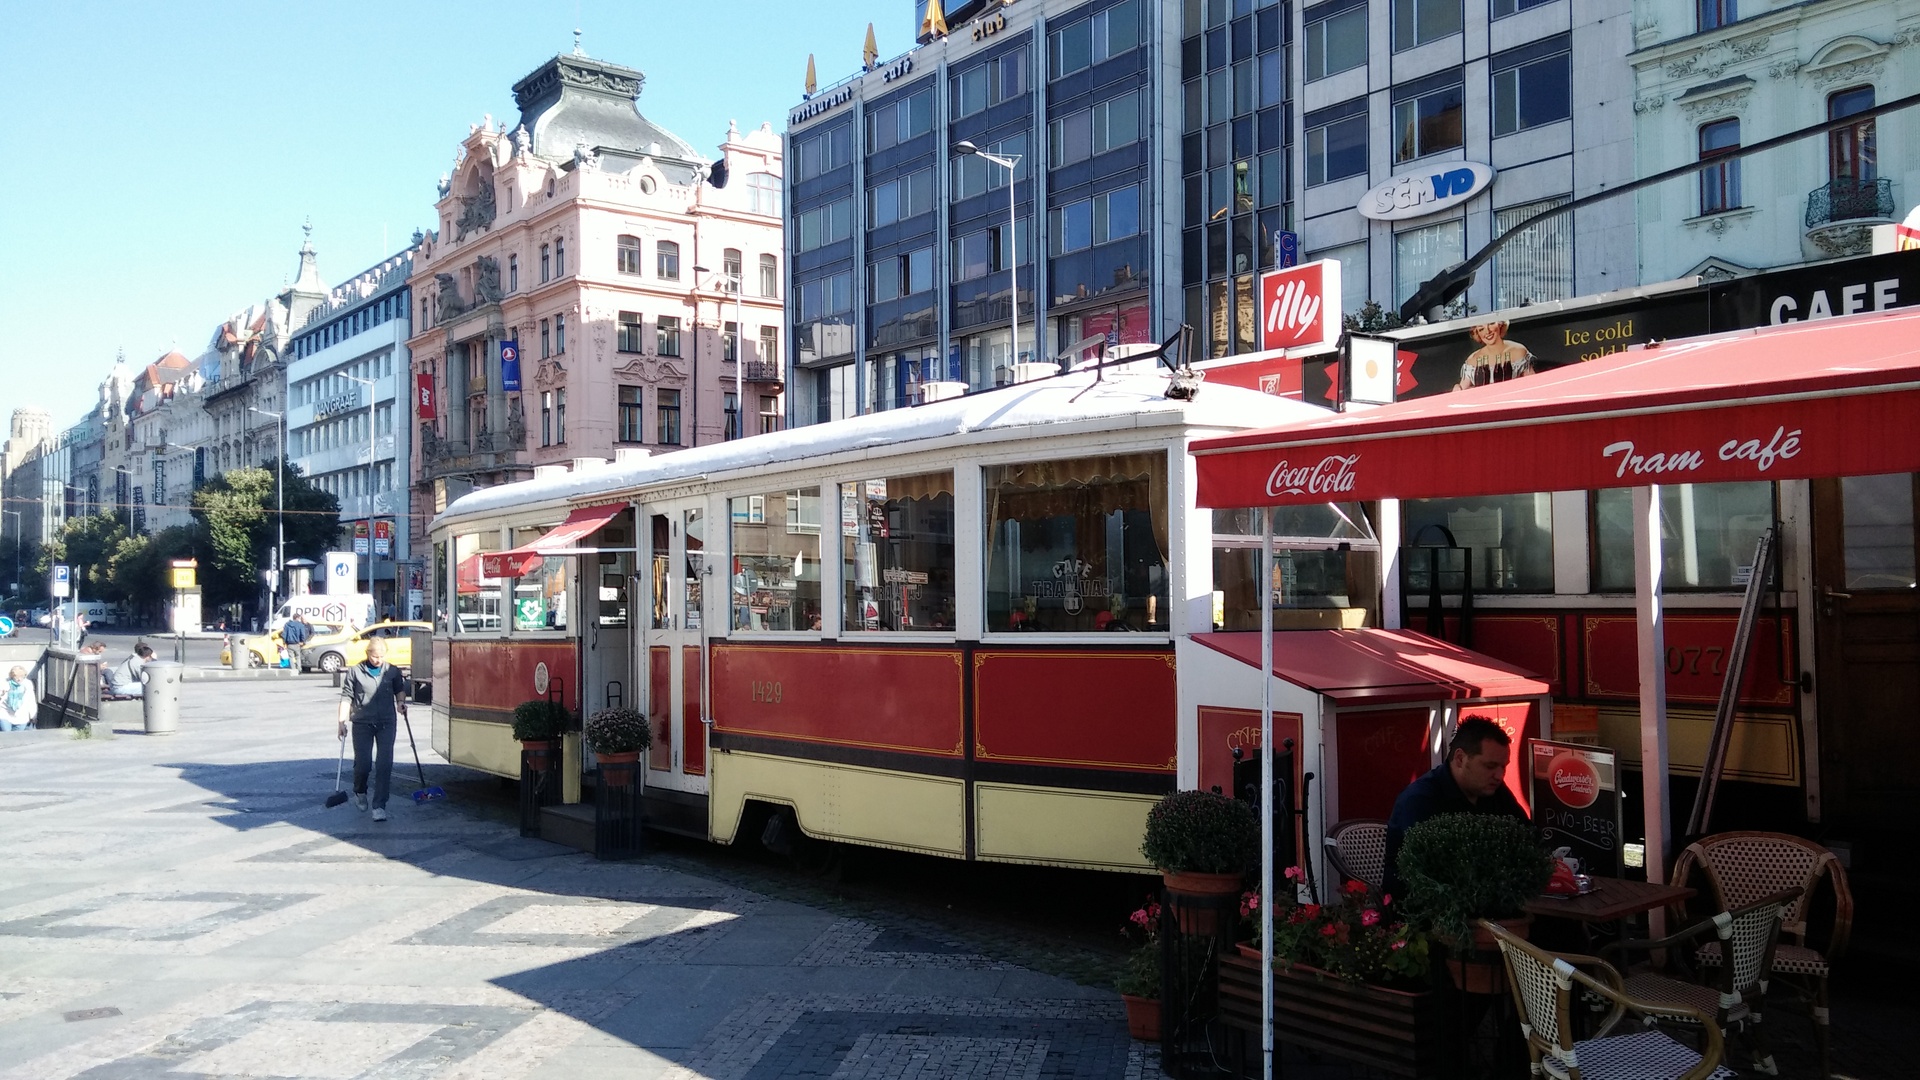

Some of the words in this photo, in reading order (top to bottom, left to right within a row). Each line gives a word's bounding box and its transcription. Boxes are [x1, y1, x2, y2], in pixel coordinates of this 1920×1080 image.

[972, 13, 1006, 42] club
[790, 86, 852, 126] restaurant
[1376, 168, 1476, 214] SČMVD
[1267, 279, 1321, 340] illy
[1770, 278, 1900, 326] CAFE
[1564, 329, 1591, 347] Ice
[1595, 320, 1634, 341] cold
[316, 400, 332, 416] VAN
[330, 391, 357, 411] GRAAF
[1603, 440, 1704, 478] Tram
[1718, 425, 1802, 472] café
[1265, 453, 1362, 497] Coca-Cola
[1052, 559, 1092, 578] CAFE
[1032, 574, 1114, 598] TRAMVAJ
[88, 608, 103, 616] GLS
[296, 607, 321, 617] DPD
[752, 680, 783, 704] 1429
[1226, 726, 1263, 752] CAF
